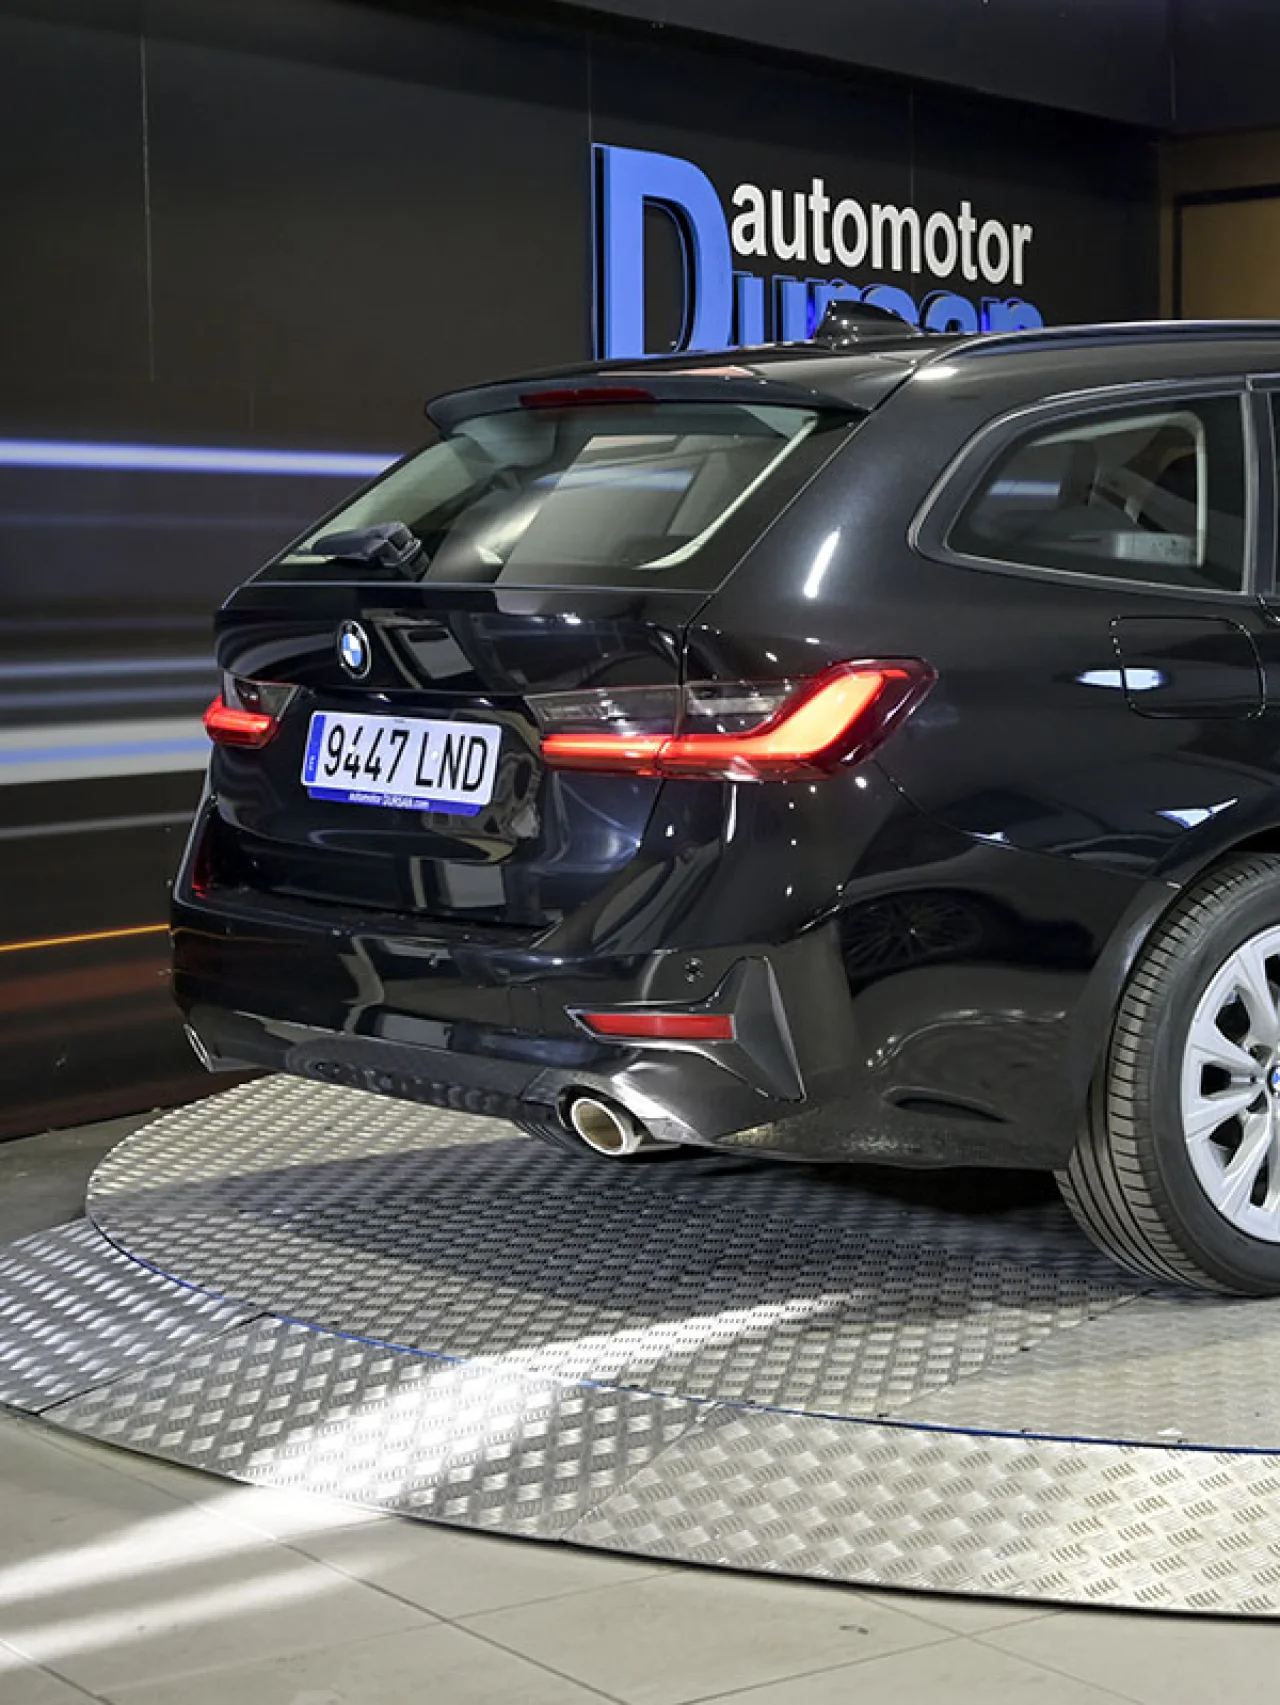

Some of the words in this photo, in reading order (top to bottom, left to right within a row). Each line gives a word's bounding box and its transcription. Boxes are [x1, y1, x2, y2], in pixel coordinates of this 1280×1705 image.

[731, 178, 1033, 286] automotor
[324, 724, 410, 784] 9447
[415, 731, 488, 792] LND
